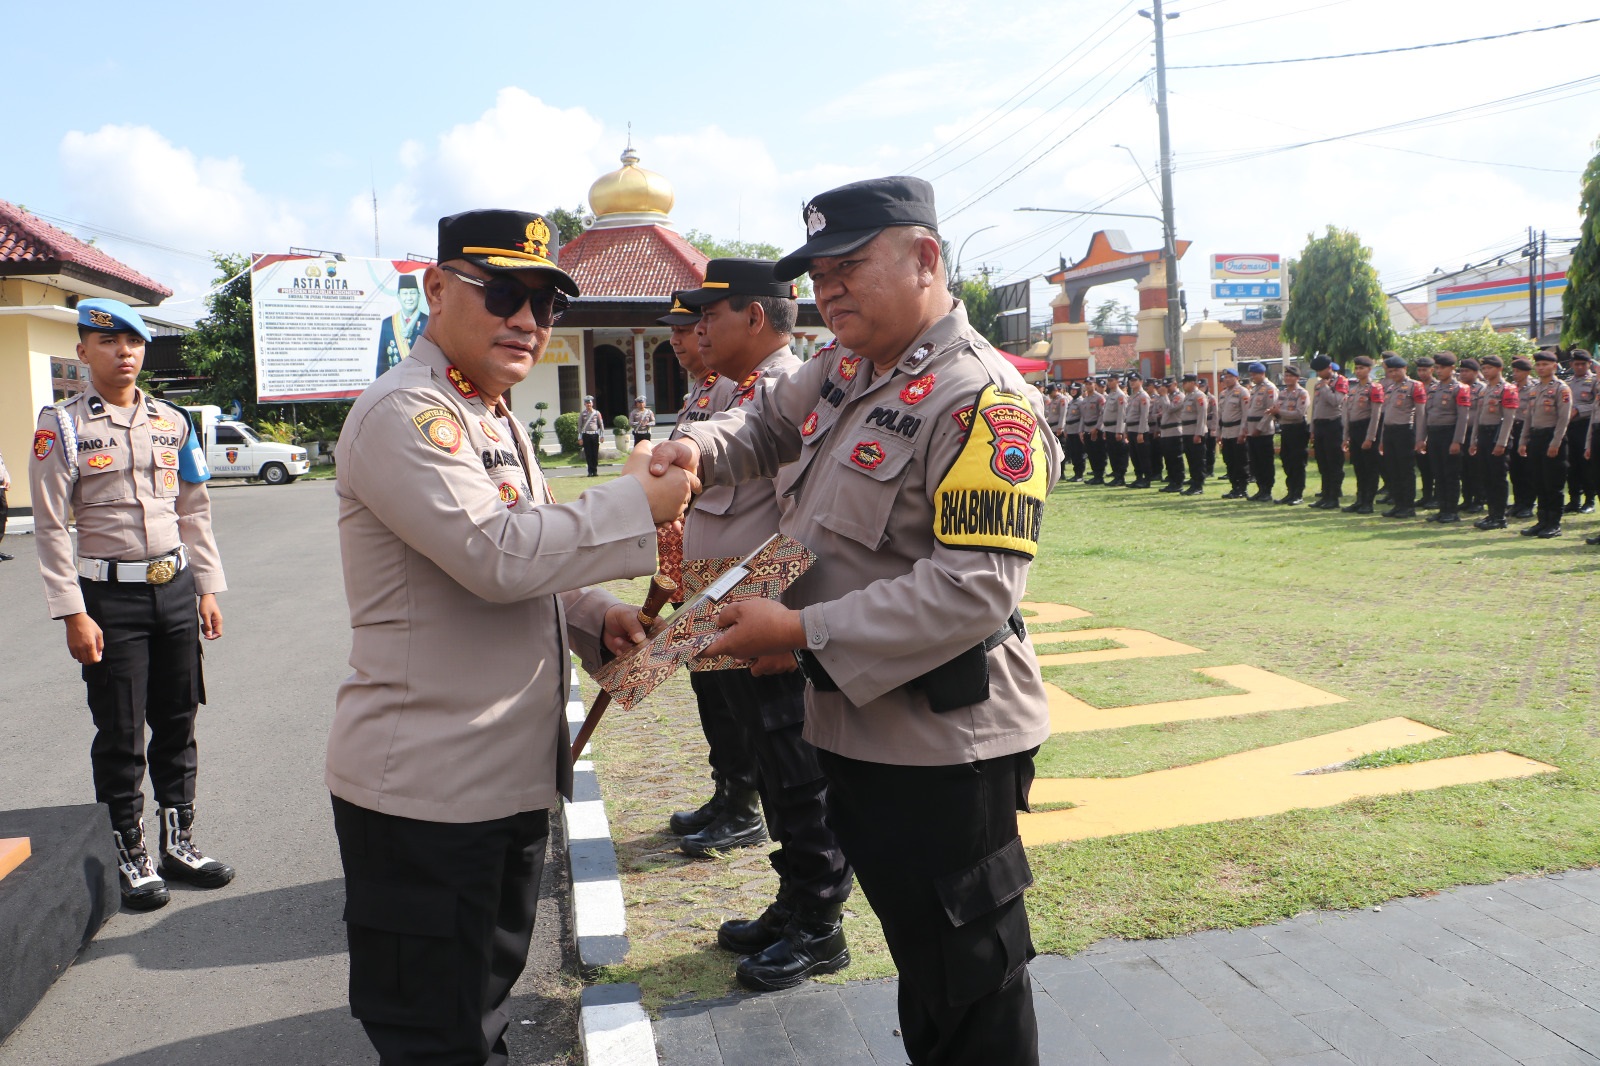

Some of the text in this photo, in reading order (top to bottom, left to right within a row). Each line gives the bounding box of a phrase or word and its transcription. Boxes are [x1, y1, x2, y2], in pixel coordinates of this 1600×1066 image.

[1227, 260, 1268, 271] Indomaret
[293, 277, 348, 290] ASTA CITA
[865, 406, 922, 438] POLRI
[989, 409, 1034, 426] POLRES
[994, 416, 1031, 429] KEBUMEN
[77, 437, 118, 452] FAIQ.A
[151, 434, 179, 447] POLRI
